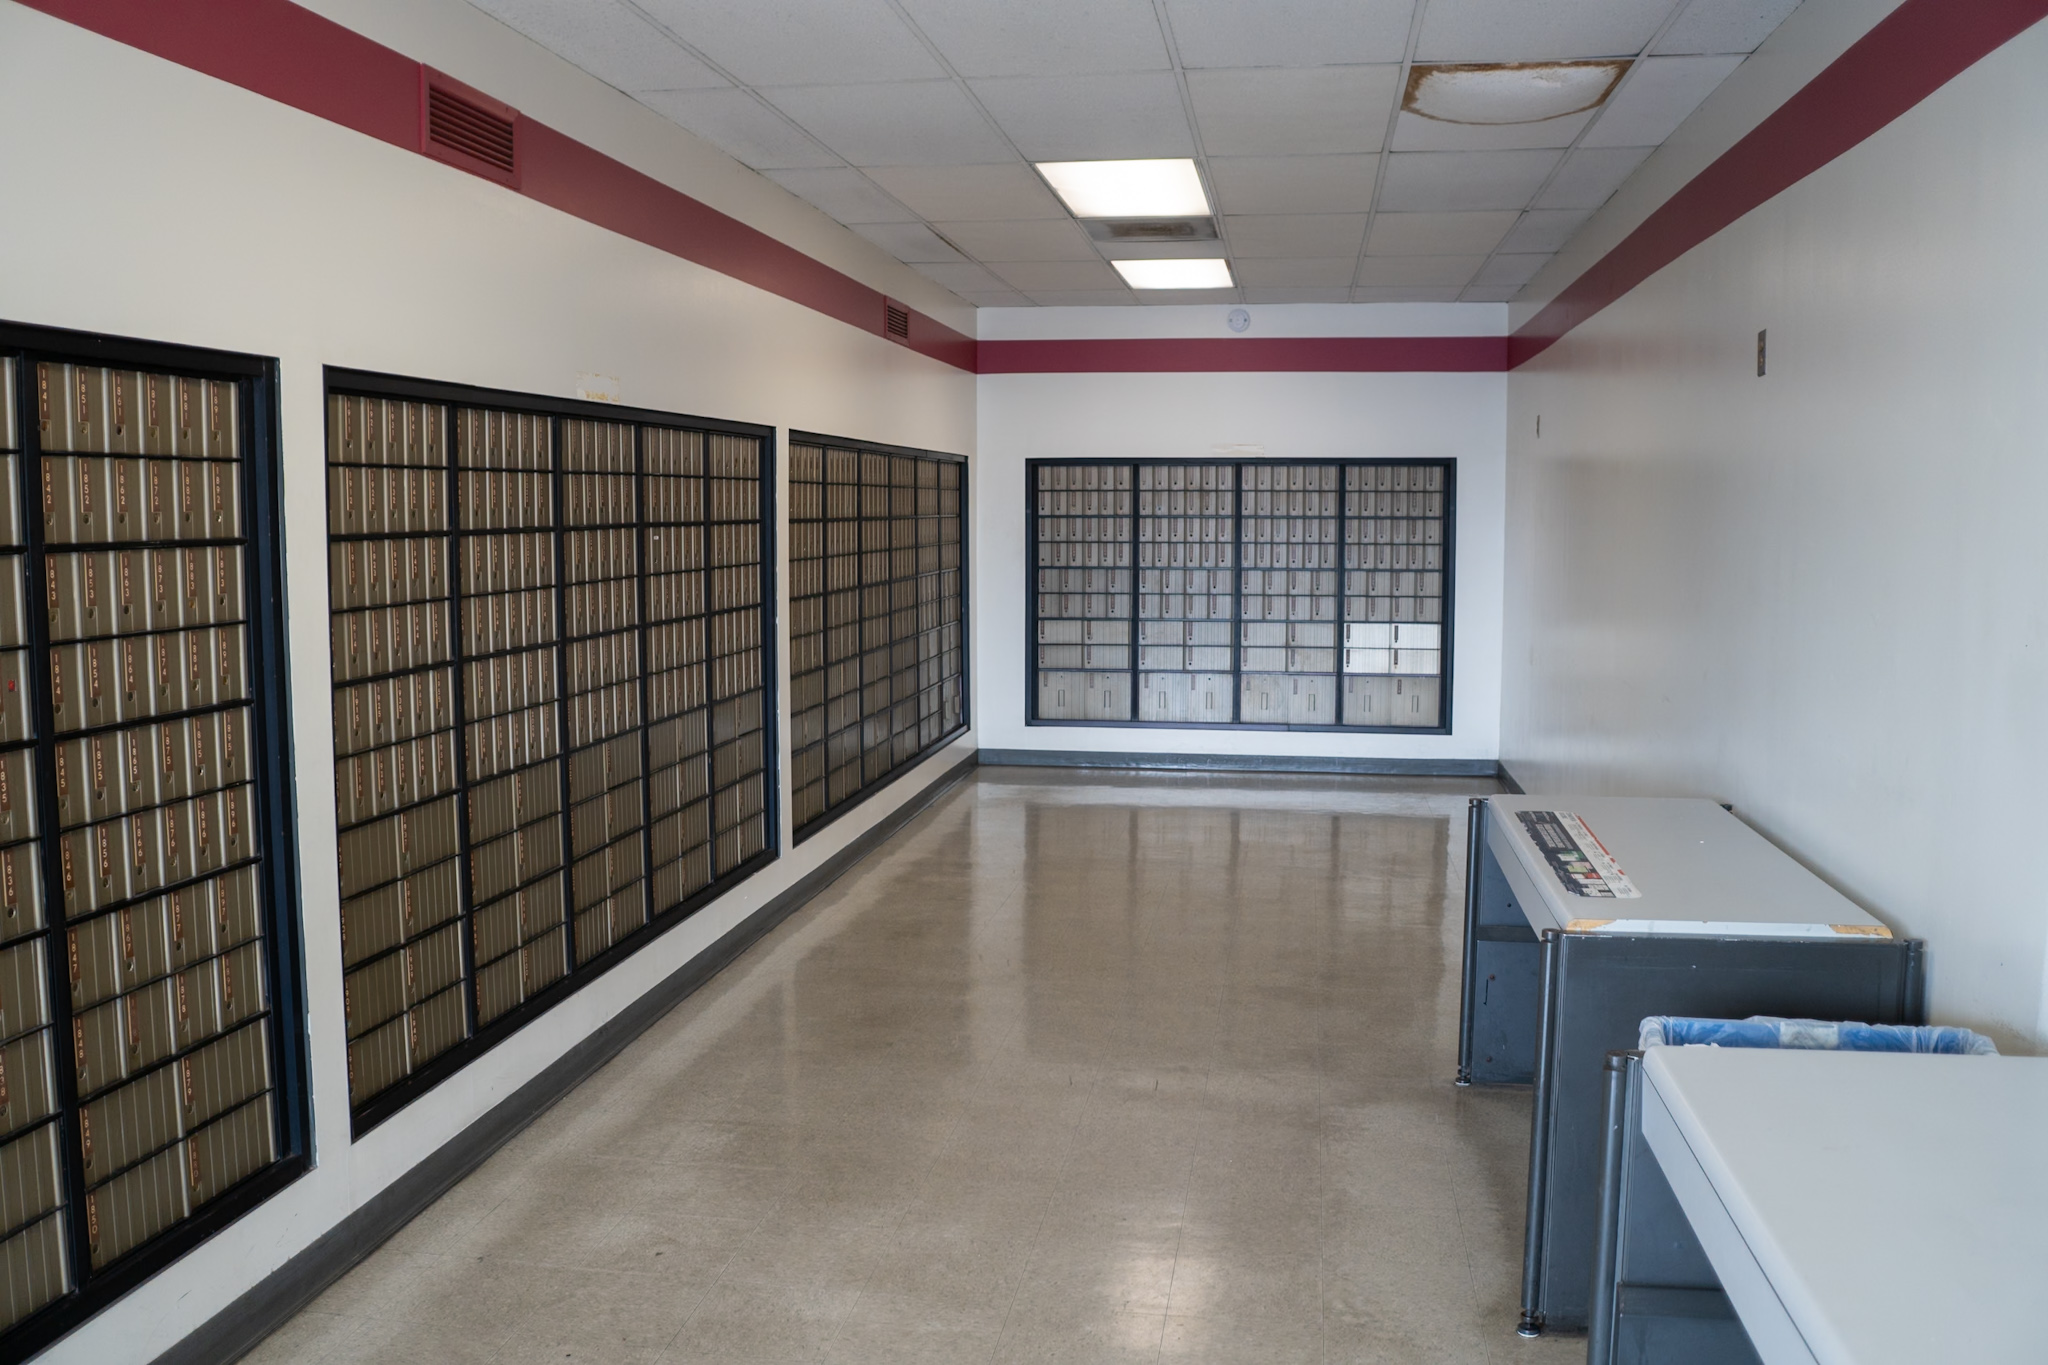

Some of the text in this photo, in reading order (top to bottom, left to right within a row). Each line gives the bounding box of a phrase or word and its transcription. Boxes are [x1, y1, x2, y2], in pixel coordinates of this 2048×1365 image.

[40, 368, 48, 412] 1841
[44, 462, 52, 504] 1842
[48, 558, 56, 600] 1843
[54, 654, 62, 695] 1844
[96, 740, 104, 780] 1855
[0, 760, 8, 803] 1835
[64, 840, 72, 882] 1846
[70, 932, 78, 974] 1847
[76, 1019, 84, 1060] 1848
